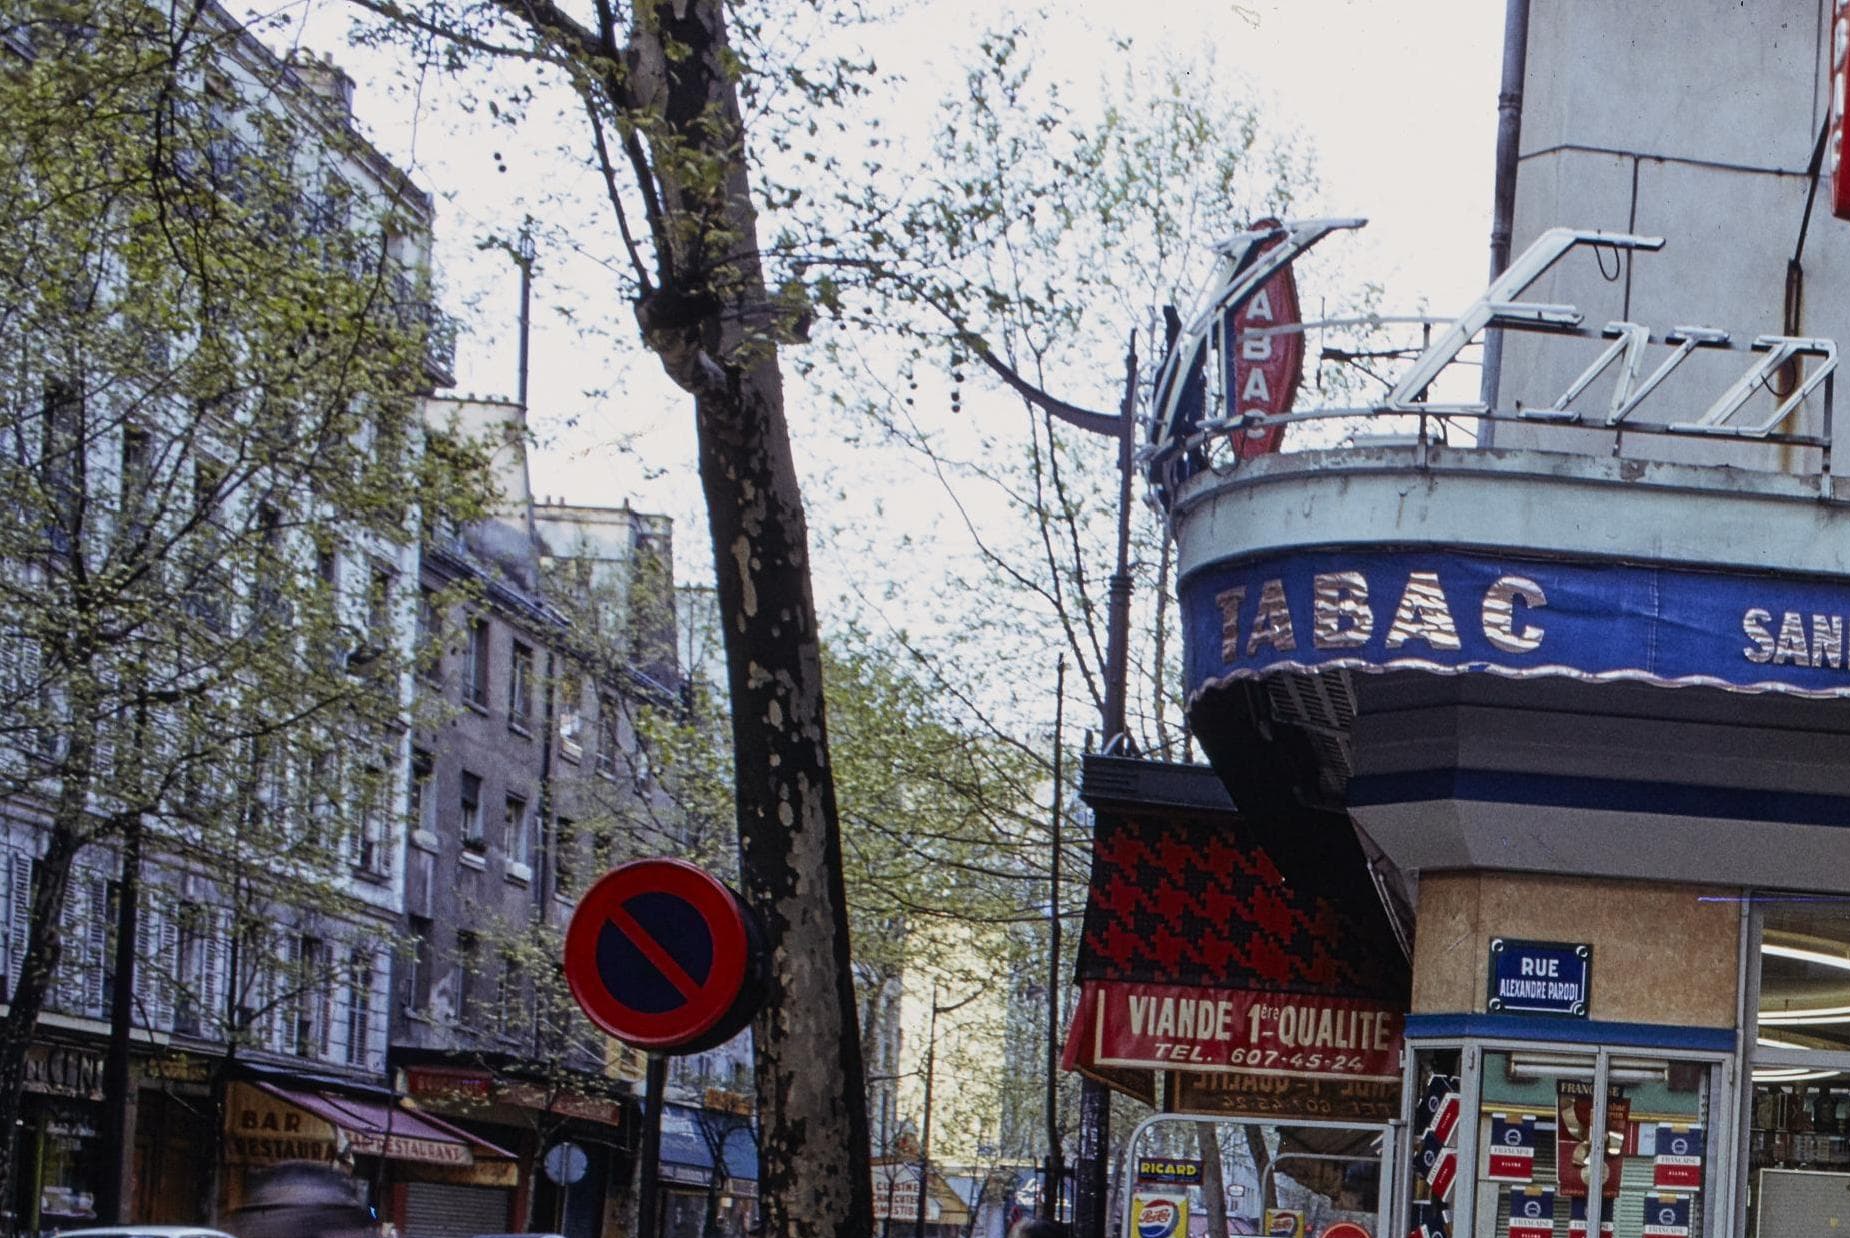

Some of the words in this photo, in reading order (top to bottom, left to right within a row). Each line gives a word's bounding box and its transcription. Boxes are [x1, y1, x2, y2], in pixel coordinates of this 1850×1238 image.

[1242, 288, 1274, 438] ABAC
[1214, 570, 1547, 661] TABAC
[1521, 957, 1559, 977] RUE
[1499, 979, 1546, 999] ALEXANDRE
[1548, 982, 1578, 1000] PARODI
[1128, 995, 1233, 1041] VIANDE
[1278, 1004, 1392, 1050] QUALITE
[1154, 1043, 1213, 1063] TEL.
[241, 1110, 300, 1132] BAR
[1140, 1162, 1197, 1176] RICARD
[876, 1182, 920, 1192] CUSINE
